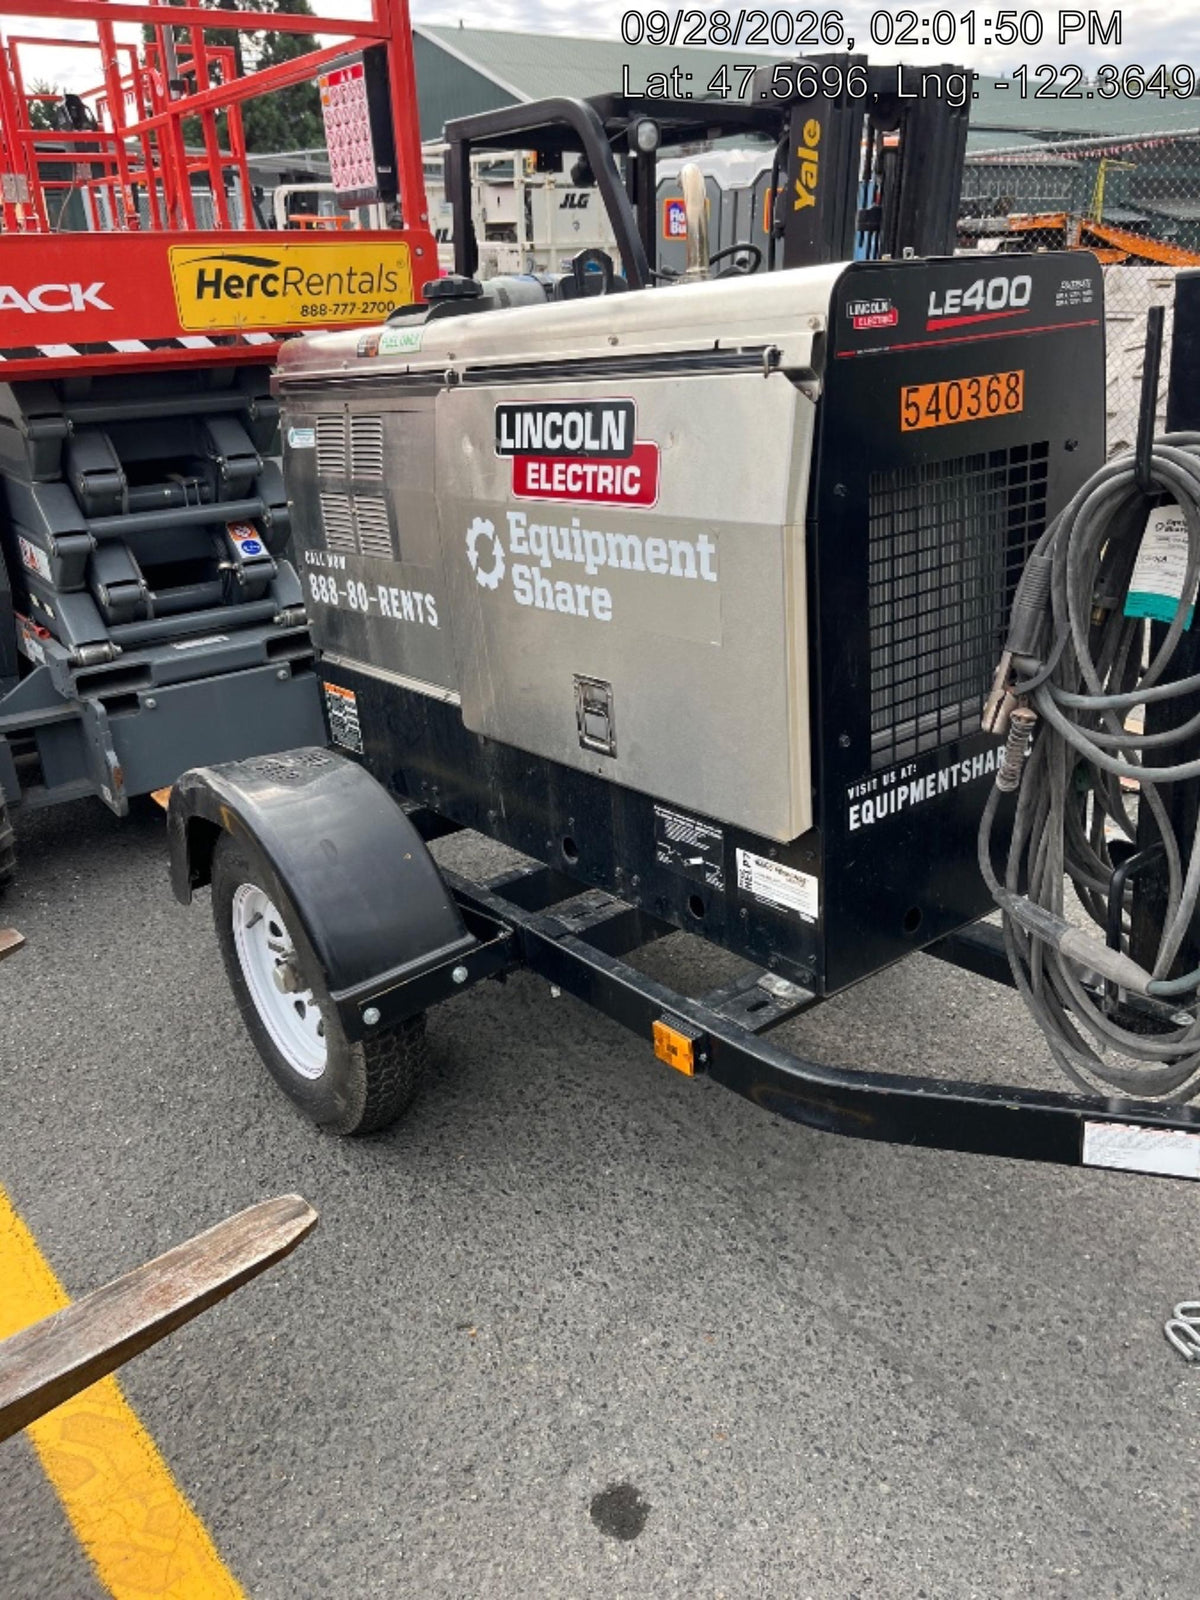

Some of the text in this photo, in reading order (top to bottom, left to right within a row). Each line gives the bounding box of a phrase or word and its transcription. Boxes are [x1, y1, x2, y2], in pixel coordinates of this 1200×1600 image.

[794, 119, 820, 210] Yale
[559, 193, 590, 209] JLG
[196, 263, 398, 300] HercRentals
[927, 275, 1032, 317] LE400
[300, 300, 396, 317] 888-777-2700
[848, 301, 889, 316] LINCOLN
[904, 373, 1021, 427] 540368
[500, 410, 627, 450] LINCOLN
[526, 462, 641, 495] ELECTRIC
[506, 511, 717, 582] Equipment
[309, 573, 438, 627] 888-80-RENTS
[512, 564, 612, 622] Share
[848, 763, 917, 800] VISIT US AT:
[849, 734, 1032, 831] EQUIPMENTSHAR
